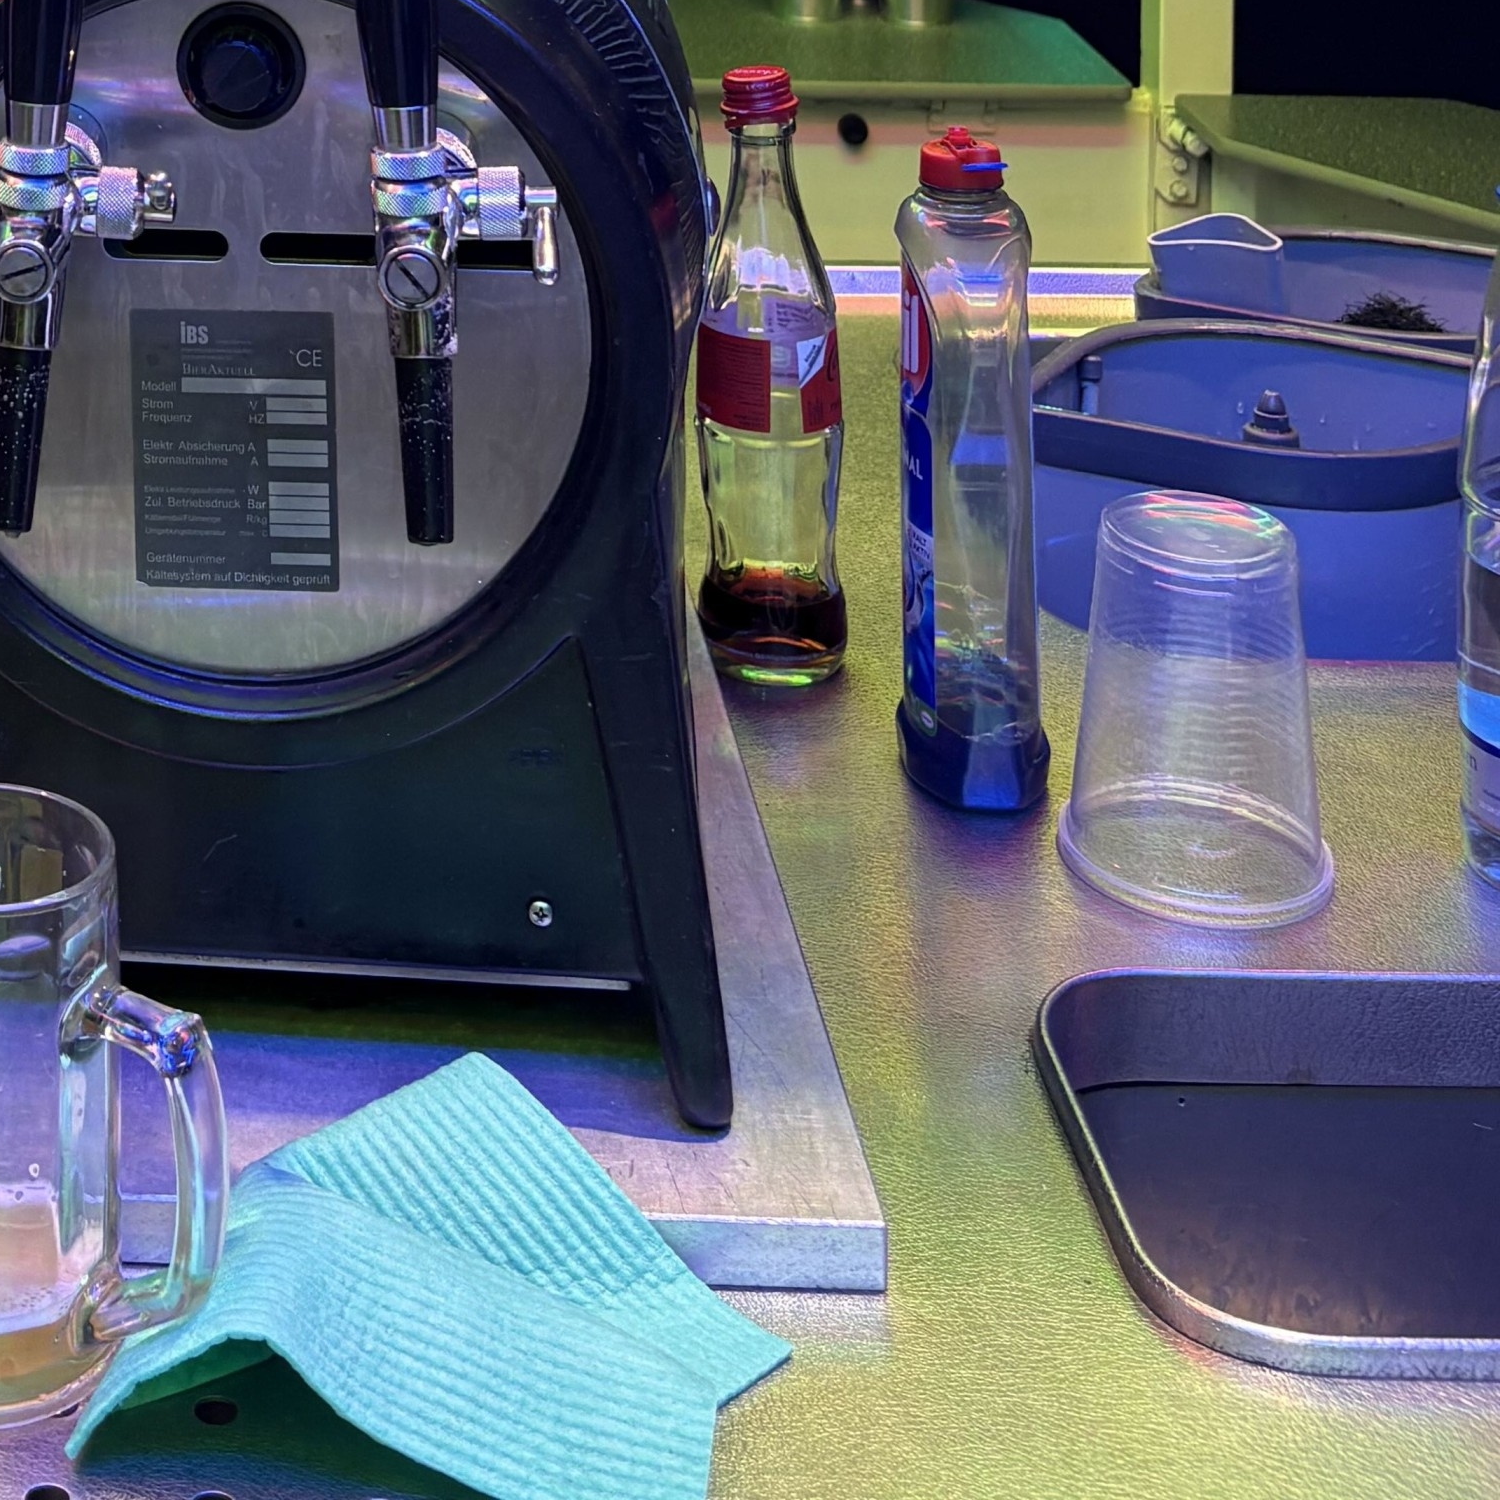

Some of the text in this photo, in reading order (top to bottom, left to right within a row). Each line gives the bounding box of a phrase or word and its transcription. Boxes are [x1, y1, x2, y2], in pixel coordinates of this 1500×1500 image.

[141, 380, 176, 392] Modell
[142, 398, 258, 410] Strom V
[142, 412, 265, 424] Frequenz HZ
[178, 441, 245, 454] Absicherung
[247, 443, 256, 452] A
[143, 454, 259, 466] Stromaufnahme A
[248, 485, 259, 495] W
[167, 497, 240, 508] Betriebsdruck
[248, 499, 266, 509] Bar
[147, 552, 226, 564] Gerätenummer
[146, 569, 331, 586] Kältesystem auf Dichtigkeit geprüft
